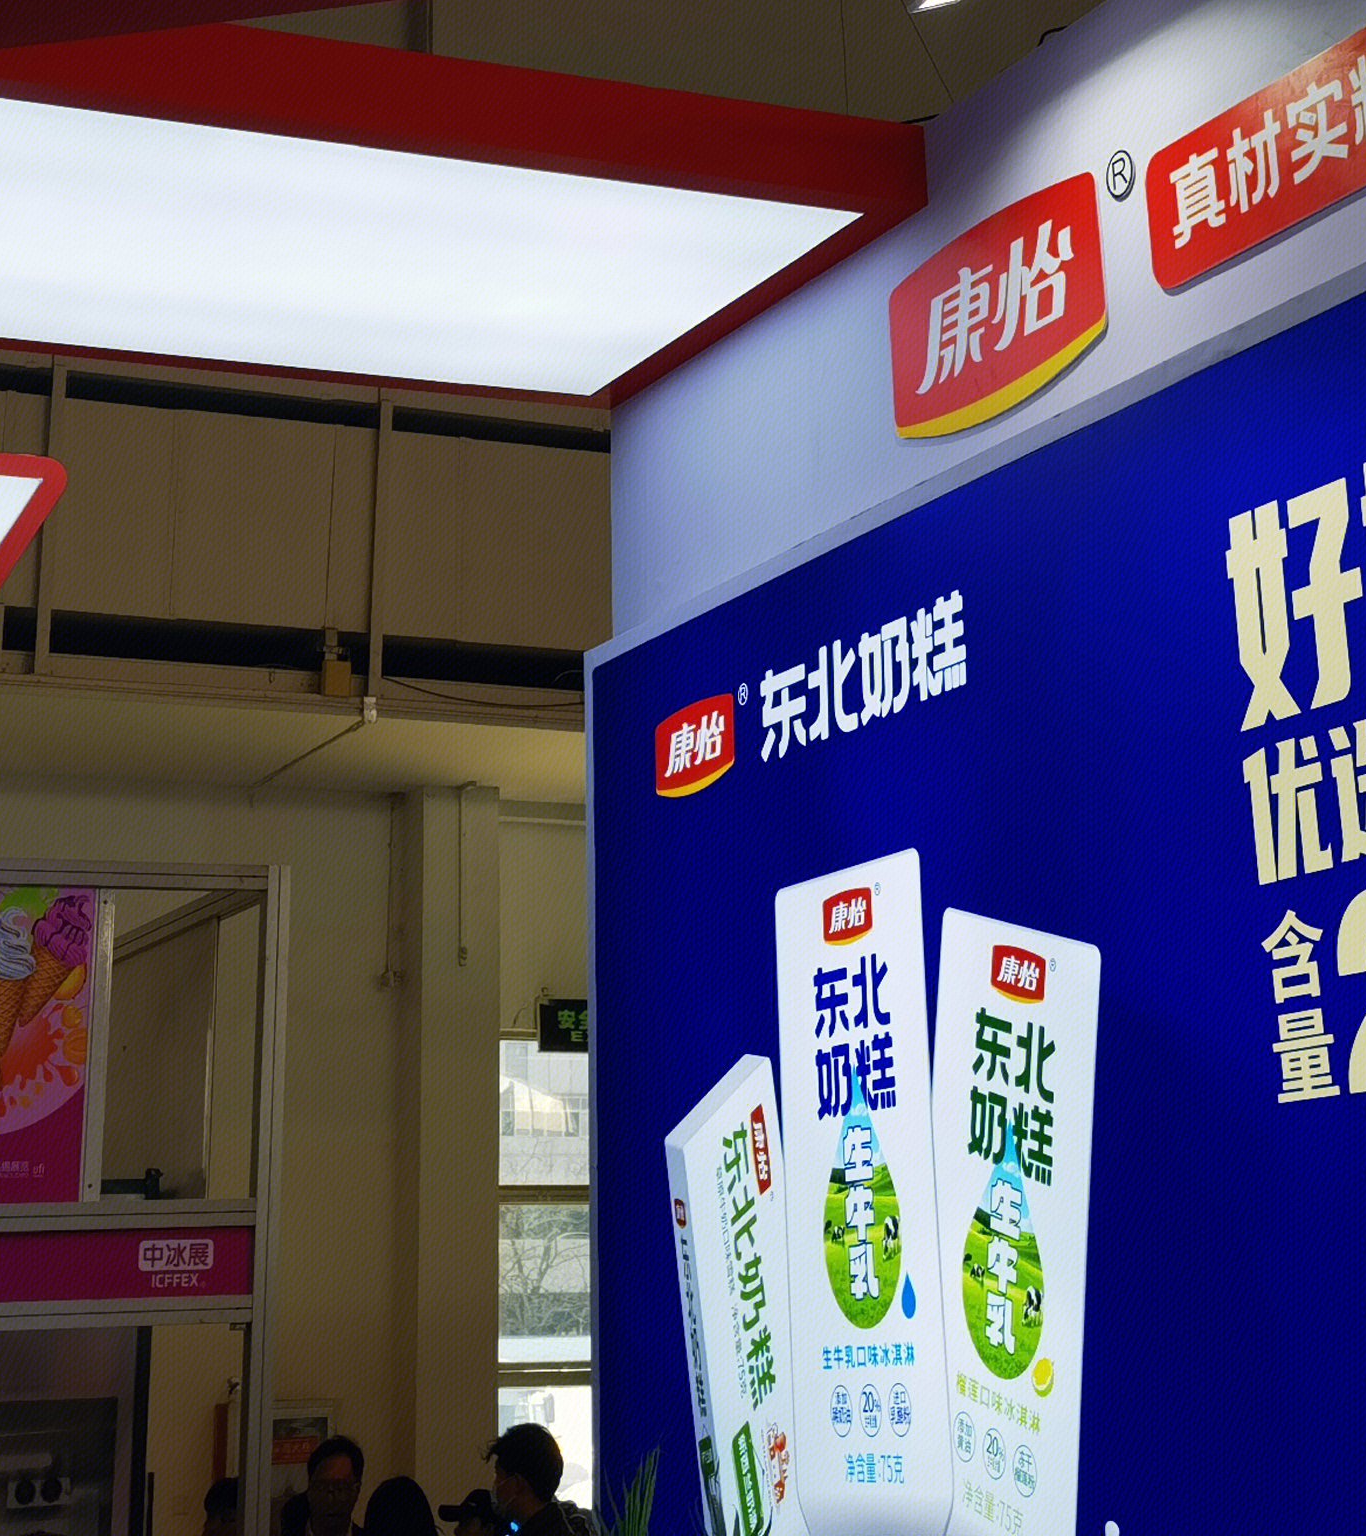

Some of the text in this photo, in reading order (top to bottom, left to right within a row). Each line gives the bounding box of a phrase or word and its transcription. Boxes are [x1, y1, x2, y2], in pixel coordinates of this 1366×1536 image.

[915, 219, 1074, 395] 康怡
[760, 589, 967, 762] 东北奶糕
[664, 711, 725, 777] 康怡
[829, 896, 867, 934] 康怡
[813, 953, 891, 1039] 东北
[996, 955, 1040, 992] 康怡
[1261, 909, 1341, 1104] 含量
[815, 1032, 897, 1120] 奶糕
[972, 1006, 1056, 1105] 东北
[967, 1085, 1053, 1186] 奶糕
[142, 1243, 210, 1269] 中冰展
[842, 1125, 880, 1301] 生牛乳
[150, 1273, 199, 1289] ICFFEX
[722, 1121, 775, 1410] 东北奶糕
[985, 1178, 1023, 1355] 生牛乳
[822, 1342, 915, 1370] 生牛乳口味冰淇淋
